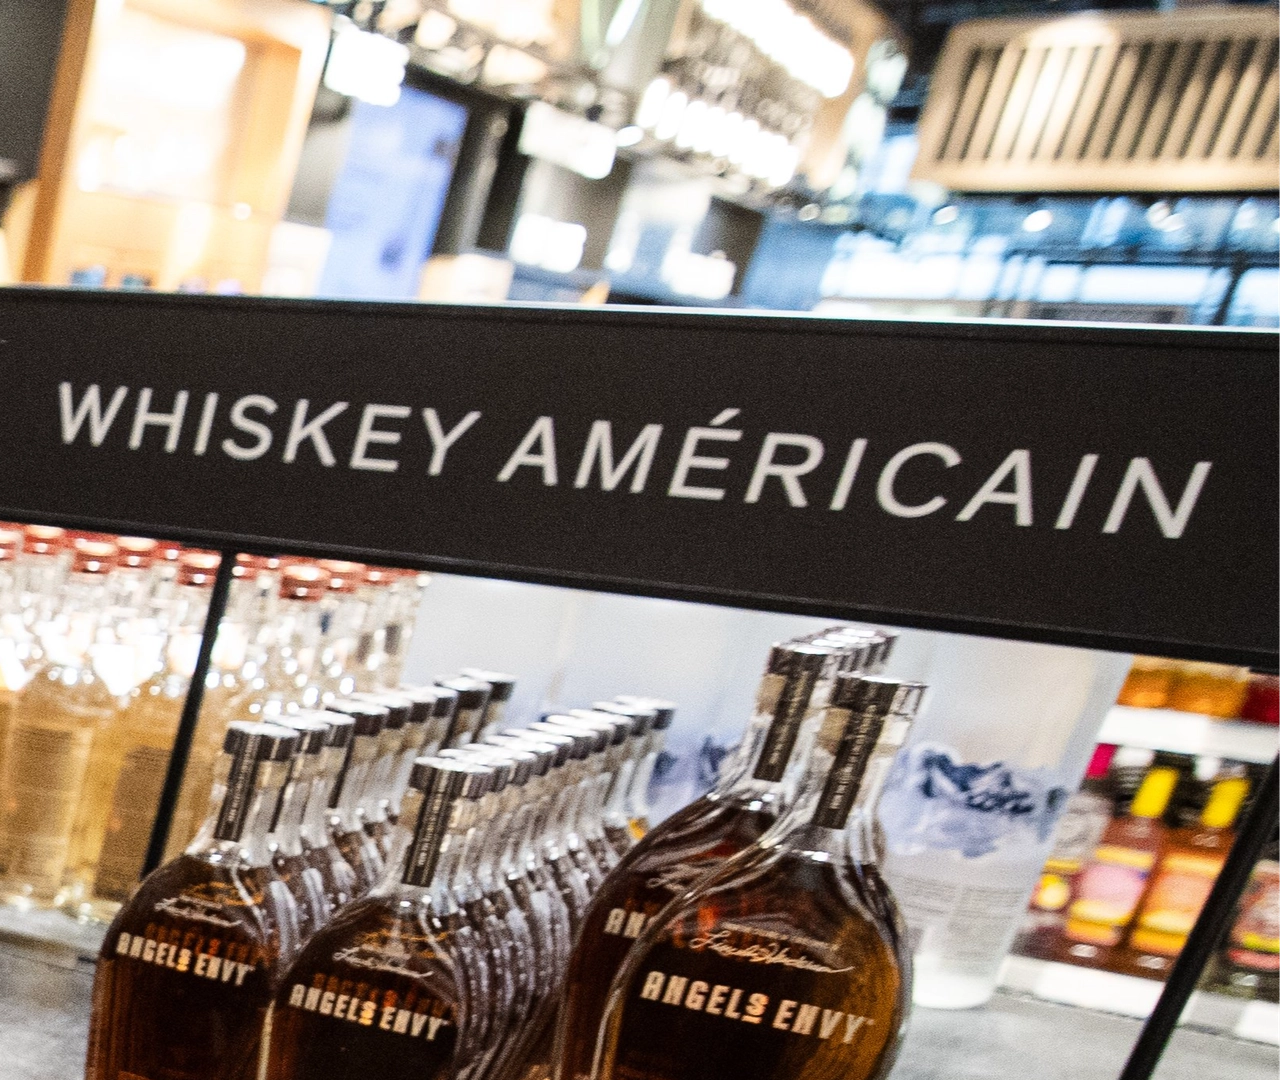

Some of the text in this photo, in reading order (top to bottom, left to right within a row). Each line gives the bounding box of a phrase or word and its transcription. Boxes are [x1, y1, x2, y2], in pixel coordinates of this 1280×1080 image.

[58, 381, 1212, 539] WHISKEY AMÉRICAIN
[194, 953, 254, 986] ENVY
[379, 1005, 449, 1041] ENVY
[772, 999, 868, 1045] ENVY
